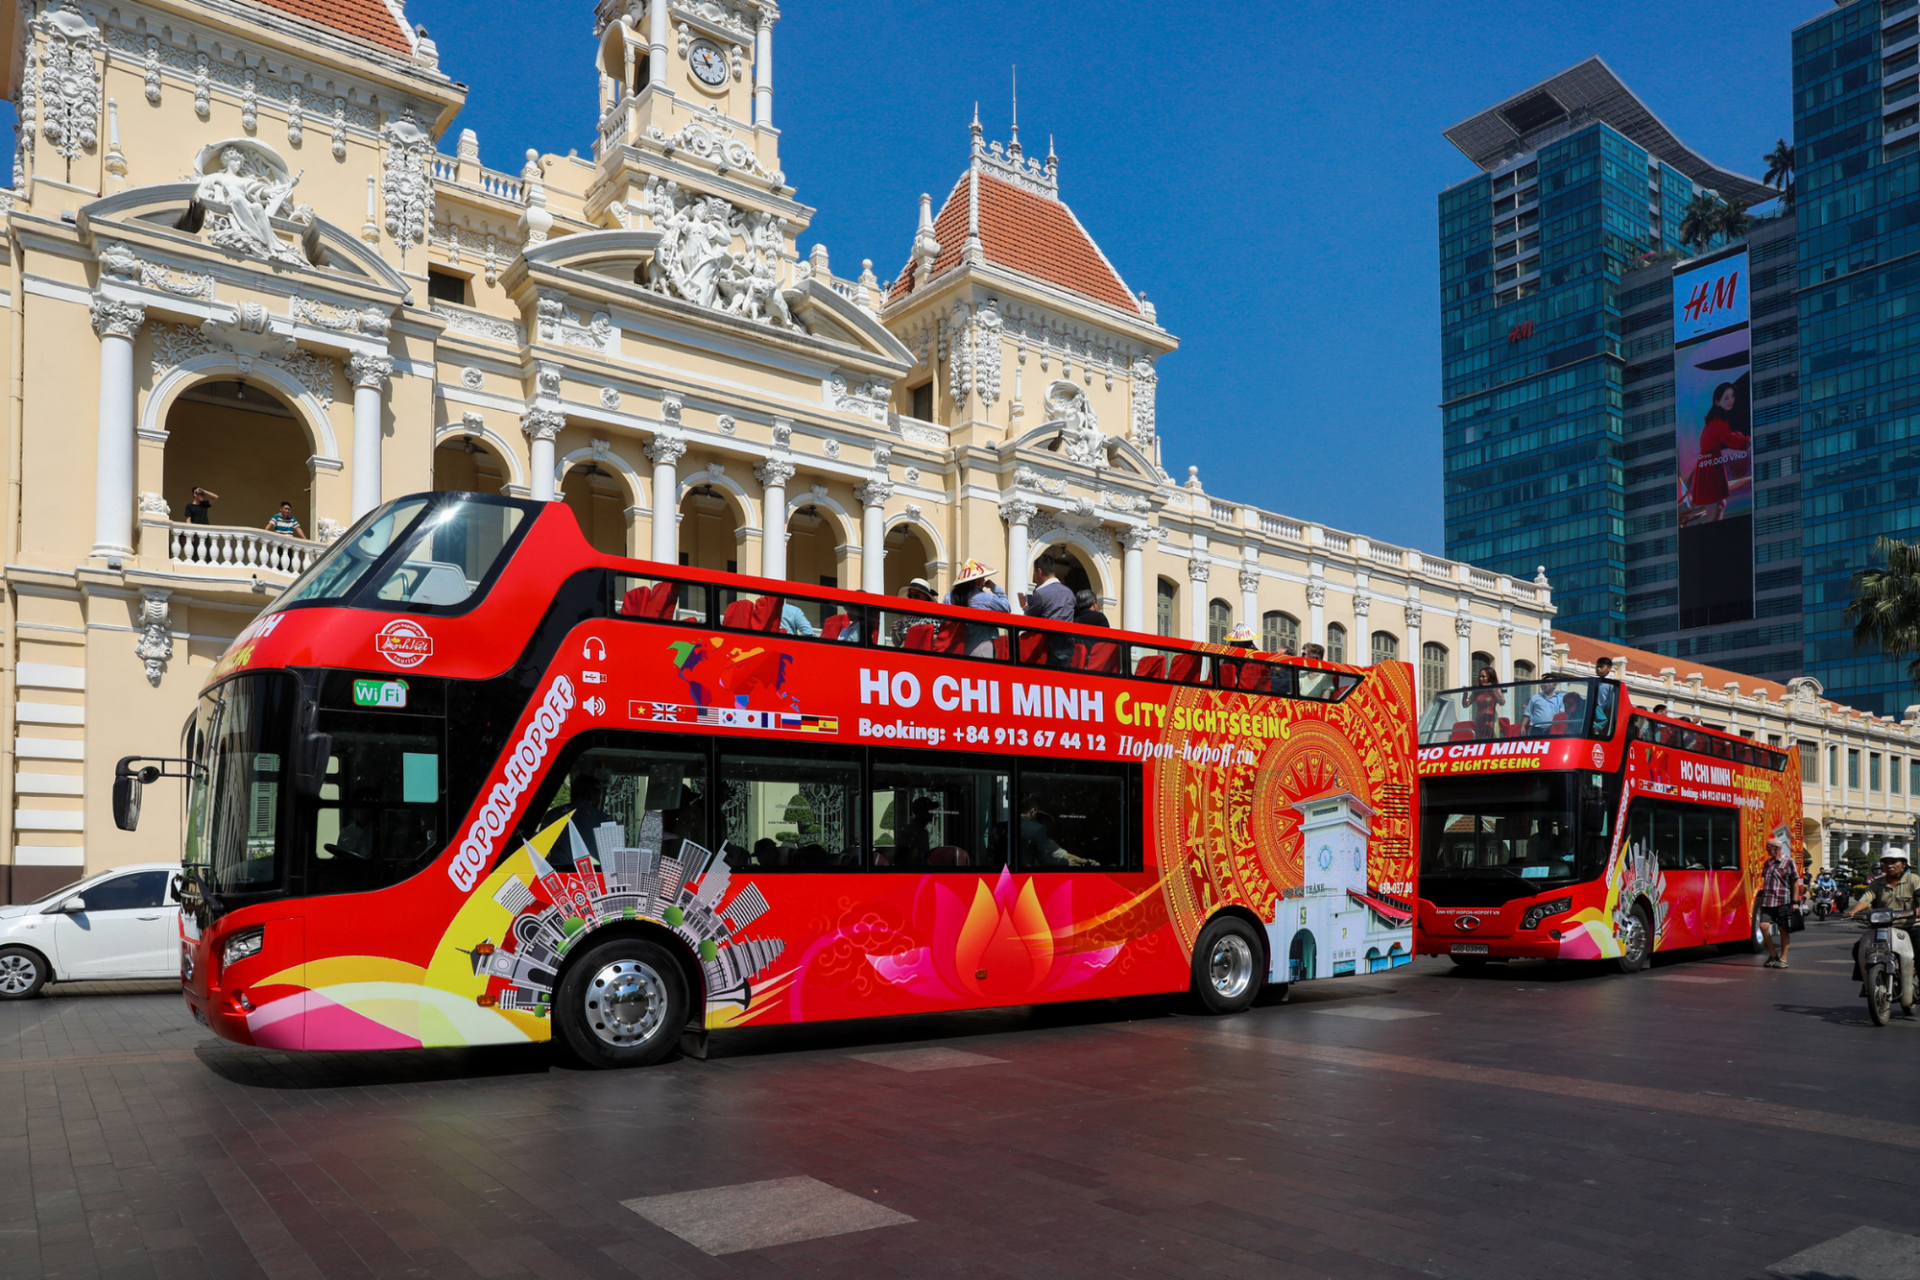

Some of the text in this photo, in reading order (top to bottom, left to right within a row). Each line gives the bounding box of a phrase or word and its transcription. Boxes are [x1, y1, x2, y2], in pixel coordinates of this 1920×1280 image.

[1683, 271, 1739, 323] H&M
[1730, 451, 1748, 461] VND
[859, 667, 922, 709] HO
[932, 674, 1001, 715] CHI
[1011, 682, 1105, 723] MINH
[1173, 705, 1292, 740] SIGHTSEEING
[858, 717, 946, 746] Booking:
[952, 725, 990, 744] +84
[994, 727, 1029, 747] 913
[1033, 730, 1056, 748] 67
[1060, 732, 1082, 750] 44
[1086, 733, 1107, 752] 12
[1418, 741, 1551, 761] HO CHI MINH
[1450, 757, 1541, 773] SIGHTSEEING
[449, 676, 575, 892] HOPON-HOPOFF
[1680, 759, 1694, 782] HO
[1694, 762, 1710, 784] CHI
[1710, 766, 1731, 787] MINH
